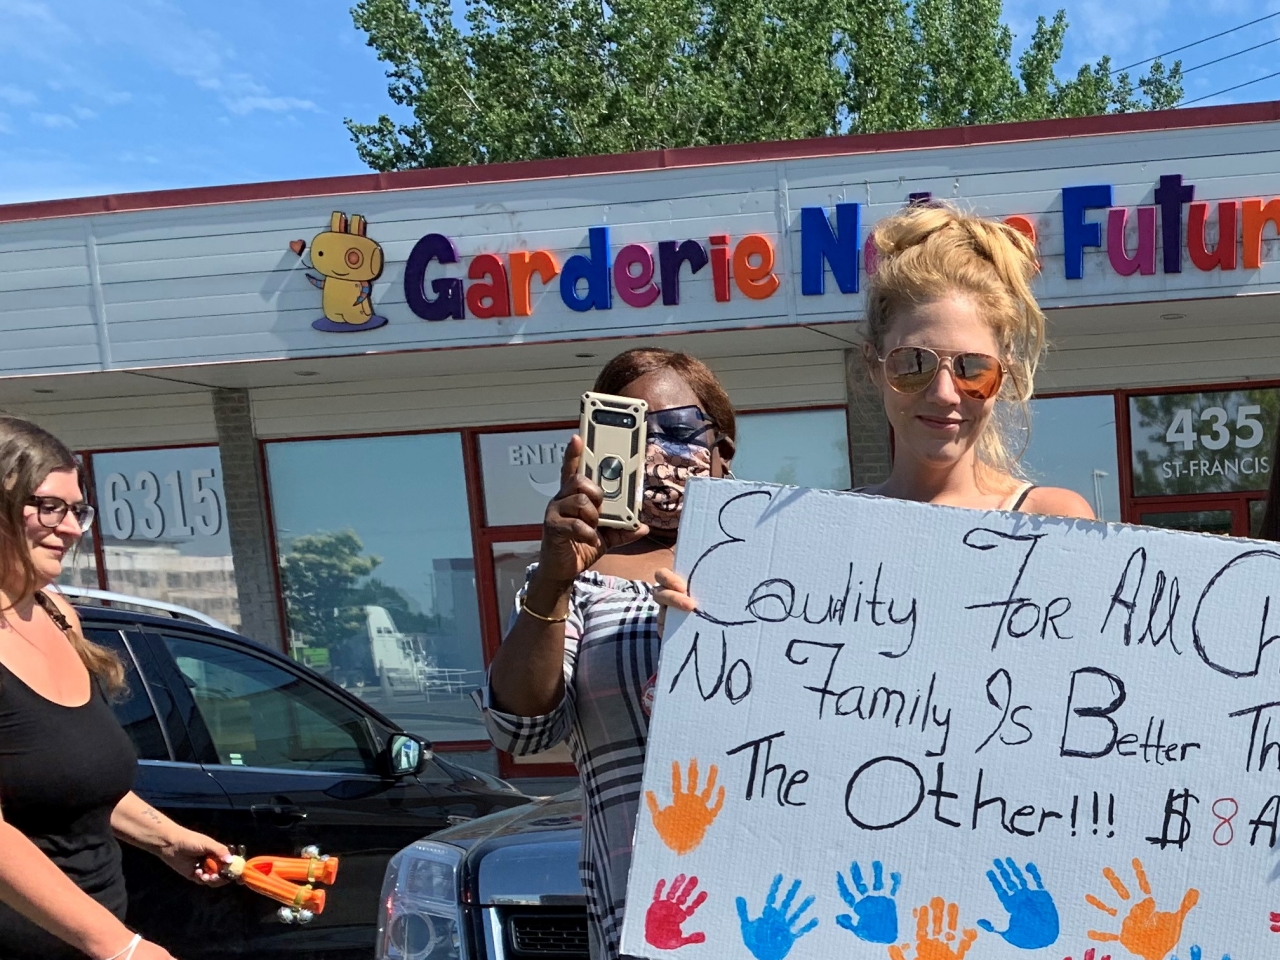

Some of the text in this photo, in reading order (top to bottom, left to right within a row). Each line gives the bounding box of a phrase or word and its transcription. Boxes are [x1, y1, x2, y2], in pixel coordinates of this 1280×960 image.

[404, 226, 781, 322] Garderie
[508, 442, 569, 467] ENTR
[1162, 456, 1271, 479] ST-FRANCIS
[1165, 405, 1264, 451] 435
[104, 468, 222, 540] 6315
[1100, 546, 1183, 656] All
[668, 630, 753, 706] No
[785, 638, 951, 757] Family
[975, 667, 1033, 754] Is
[1060, 666, 1201, 766] Better
[726, 731, 809, 807] The
[844, 756, 1115, 838] Other!!!
